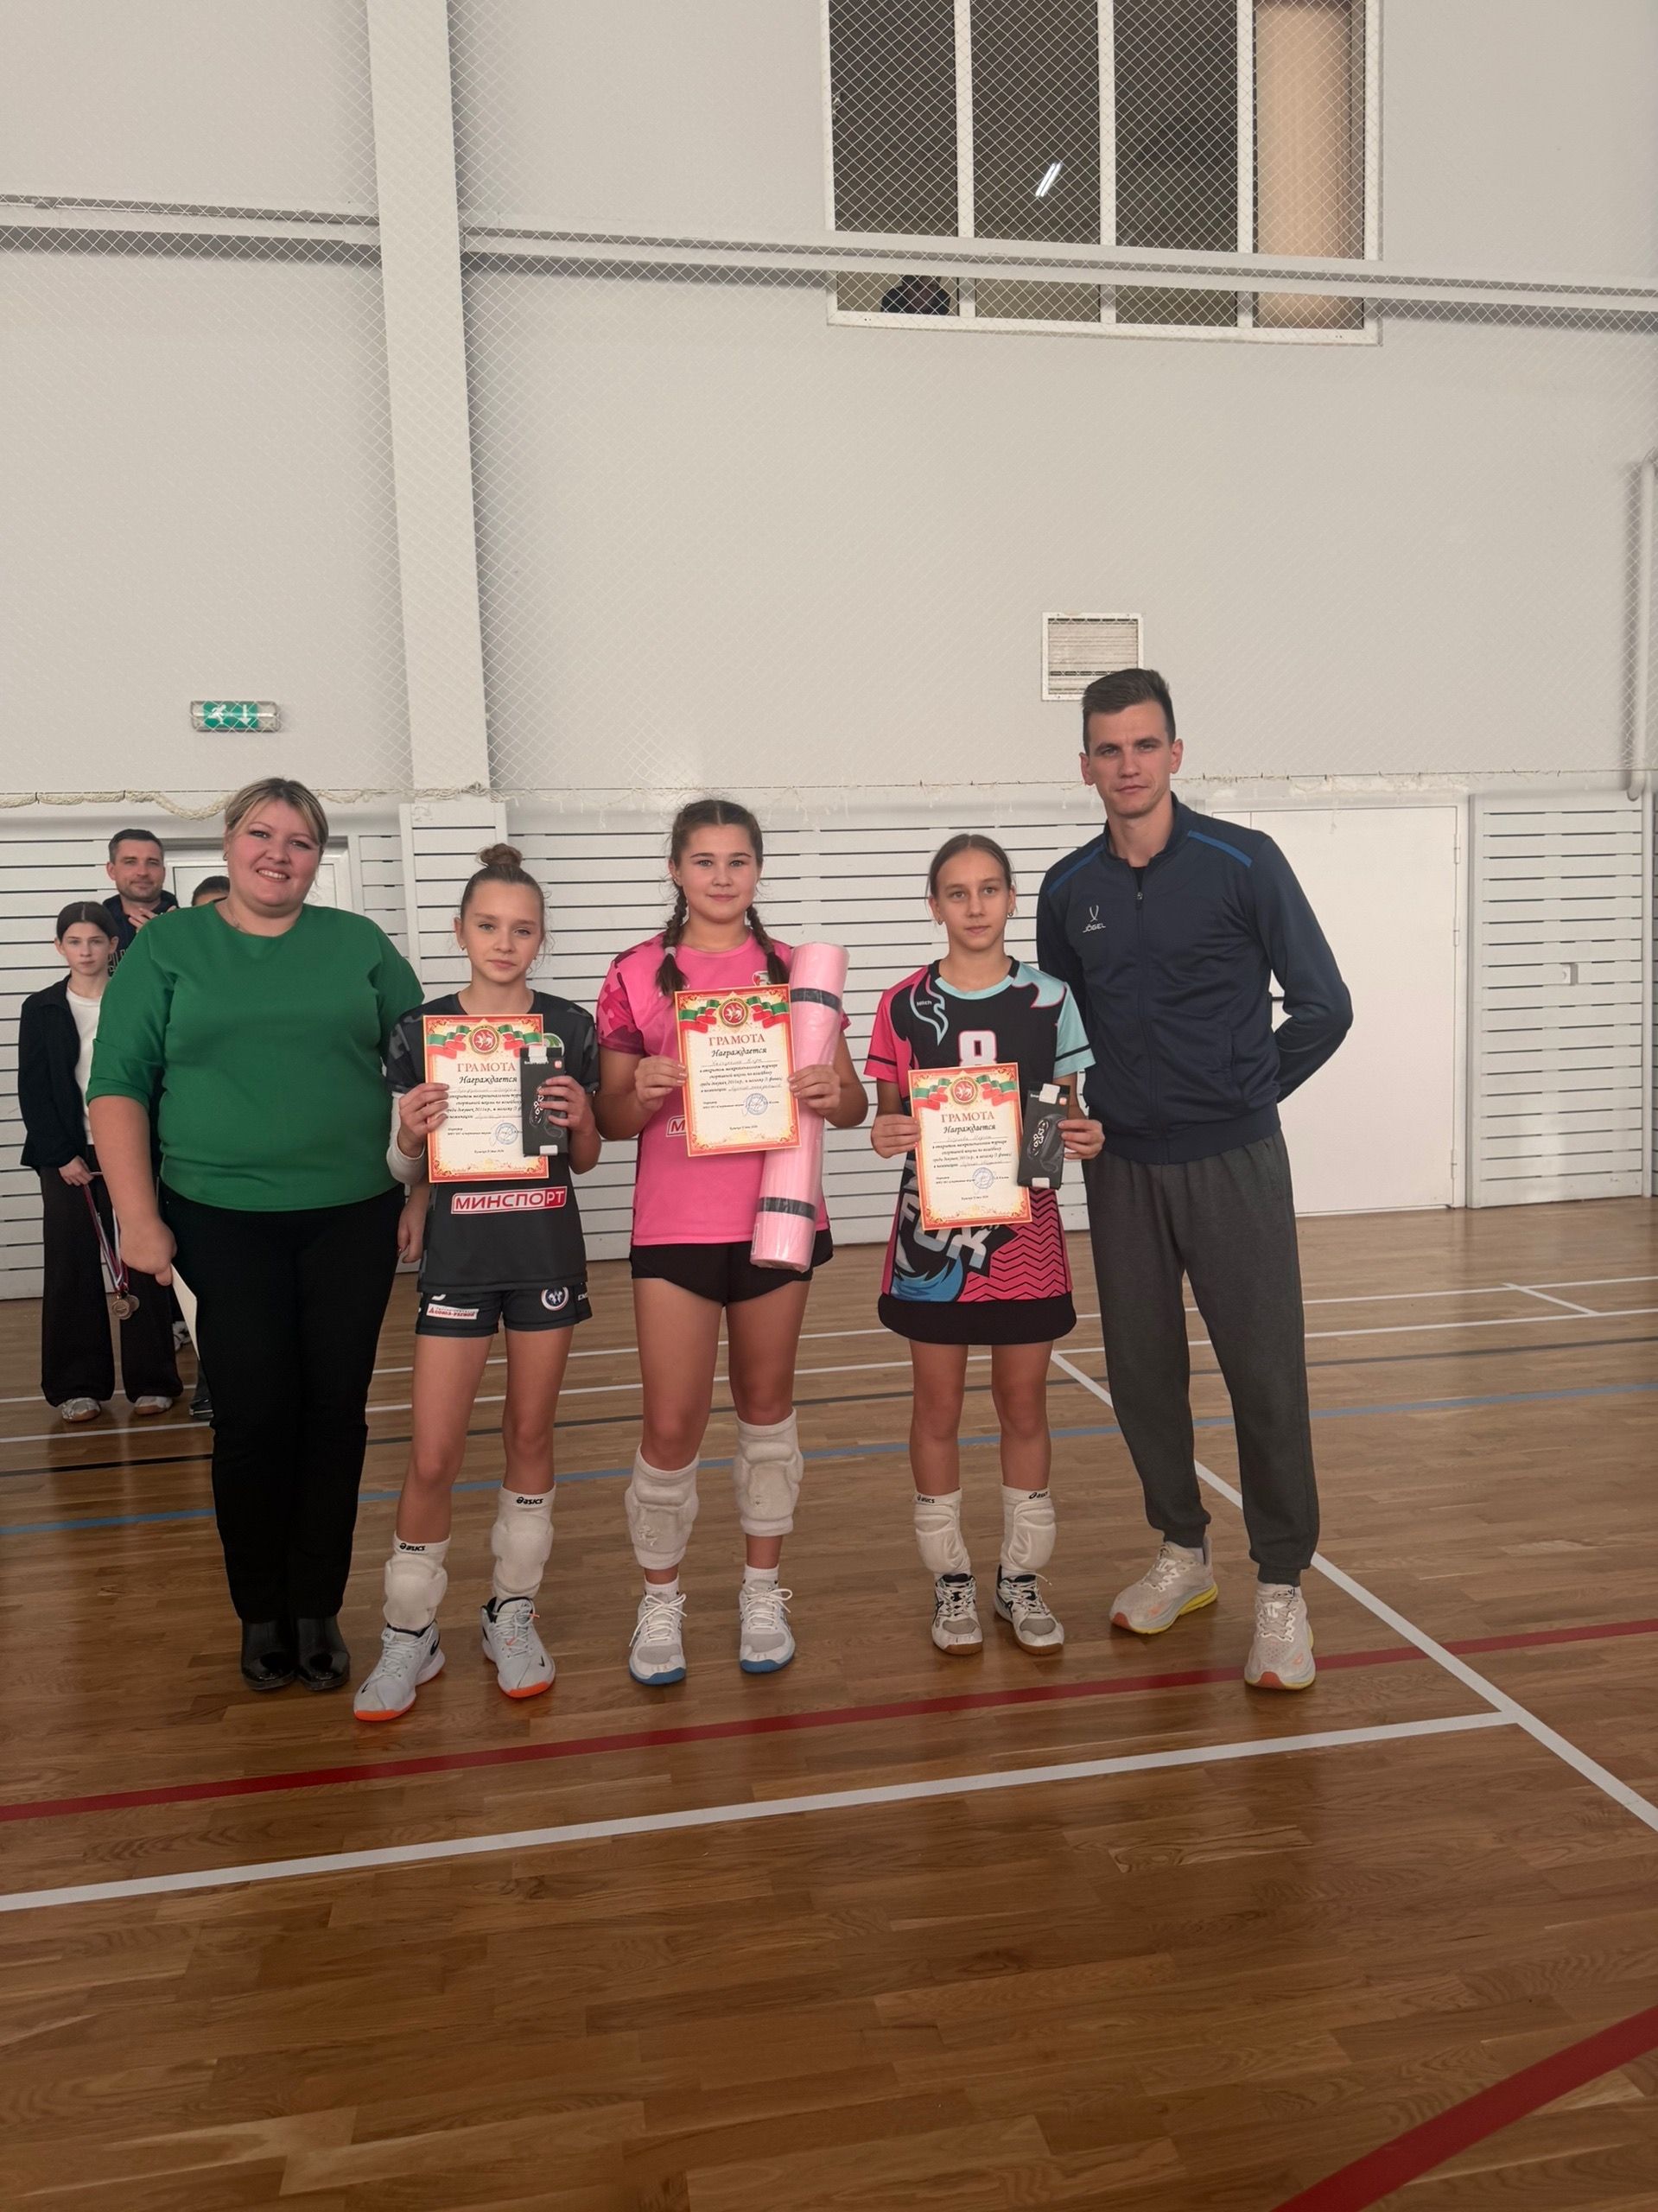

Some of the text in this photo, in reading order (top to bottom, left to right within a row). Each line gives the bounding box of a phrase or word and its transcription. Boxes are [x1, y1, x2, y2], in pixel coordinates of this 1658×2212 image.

[708, 1033, 765, 1046] ГРАМОТА
[711, 1046, 767, 1058] Награждается
[457, 1062, 516, 1072] ГРАМОТА
[459, 1074, 518, 1086] Награждается
[941, 1110, 995, 1123] ГРАМОТА
[943, 1123, 996, 1135] Награждается
[455, 1190, 565, 1211] МИНСПОРТ
